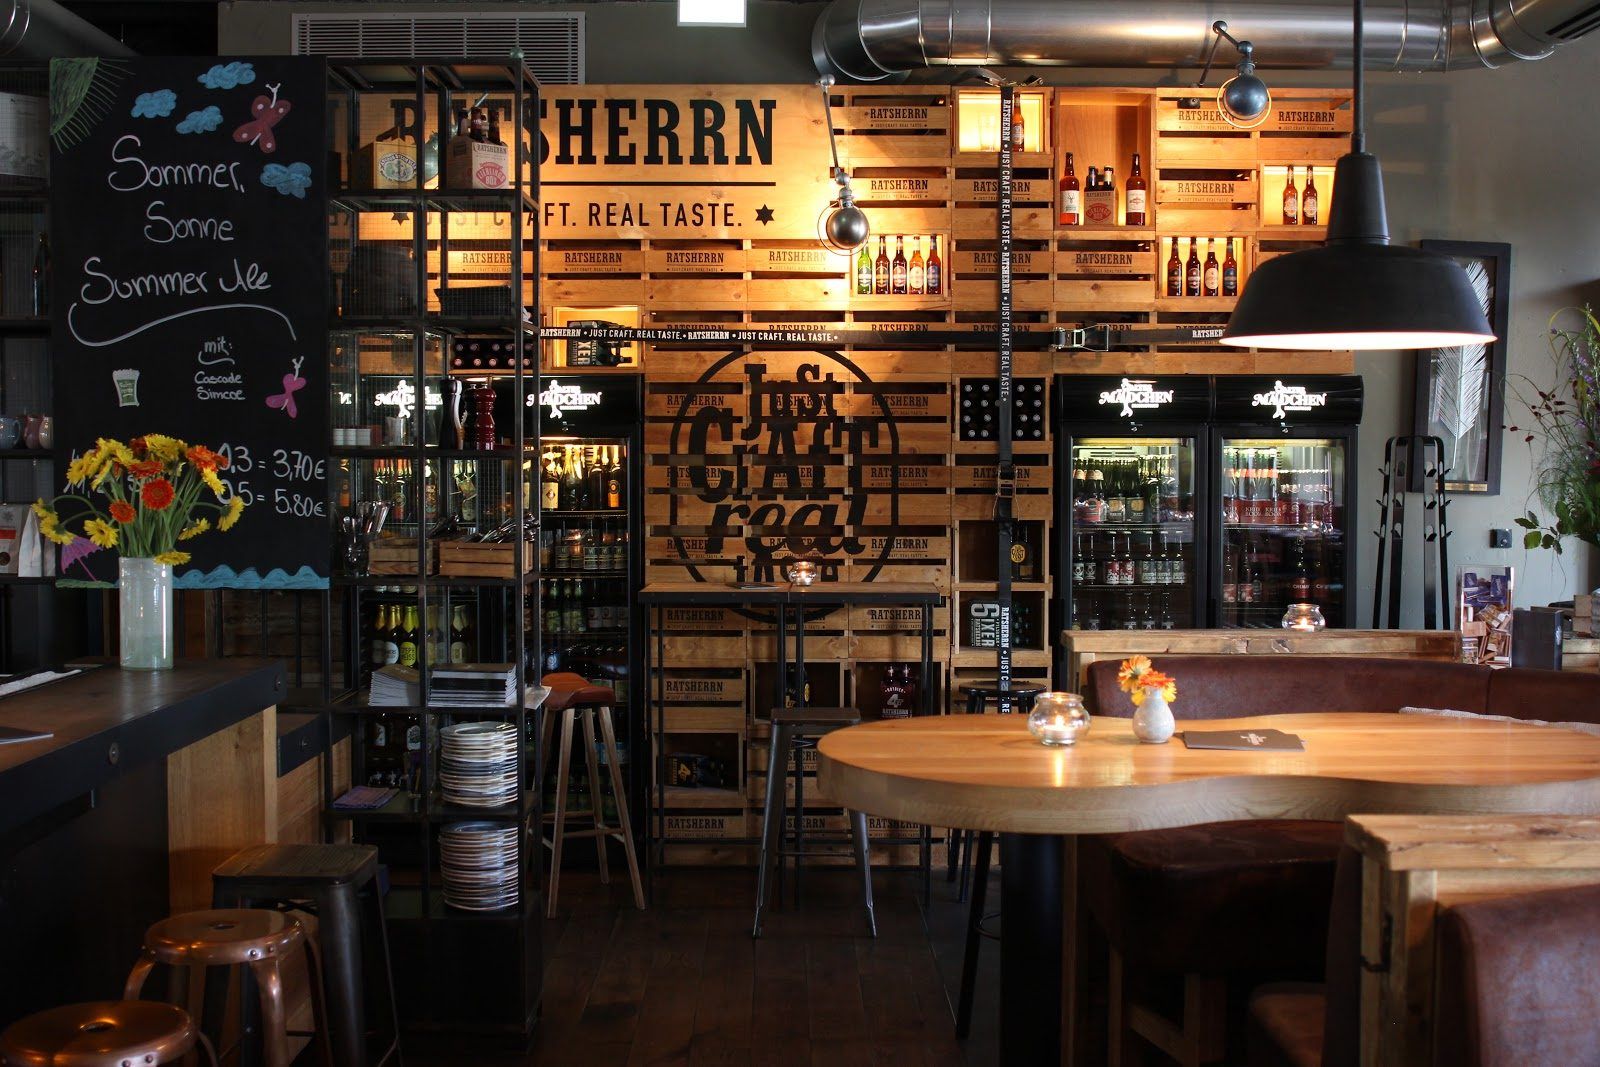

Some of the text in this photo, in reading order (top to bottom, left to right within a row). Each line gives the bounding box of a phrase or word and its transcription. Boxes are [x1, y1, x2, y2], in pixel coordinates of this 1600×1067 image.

[870, 108, 928, 119] RATSHERRN
[1278, 111, 1335, 122] RATSHERRN
[108, 134, 245, 193] Sommer,
[871, 179, 928, 190] RATSHERRN
[1178, 182, 1235, 194] RATSHERRN
[588, 202, 650, 226] REAL
[660, 202, 742, 226] TASTE.
[144, 200, 234, 243] Sonne
[1001, 99, 1011, 397] RATSHERRN JUST CRAFT. REAL TASTE. RATSHERRN JUST CRAFT. REAL TASTE.
[564, 252, 622, 264] RATSHERRN
[666, 252, 724, 263] RATSHERRN
[769, 250, 827, 262] RATSHERRN
[1076, 254, 1133, 265] RATSHERRN
[81, 256, 207, 304] Summer
[540, 328, 834, 342] RATSHERRN JUST CRAFT. REAL TASTE. RATSHERRN JUST CRAFT. REAL TASTE.
[204, 336, 233, 355] mit:
[194, 370, 243, 384] Cascade
[197, 386, 246, 400] Simcoe
[667, 609, 724, 621] RATSHERRN
[1001, 606, 1010, 648] RATSHERRN
[1001, 654, 1009, 675] JUST
[666, 681, 723, 692] RATSHERRN
[667, 818, 724, 829] RATSHERRN
